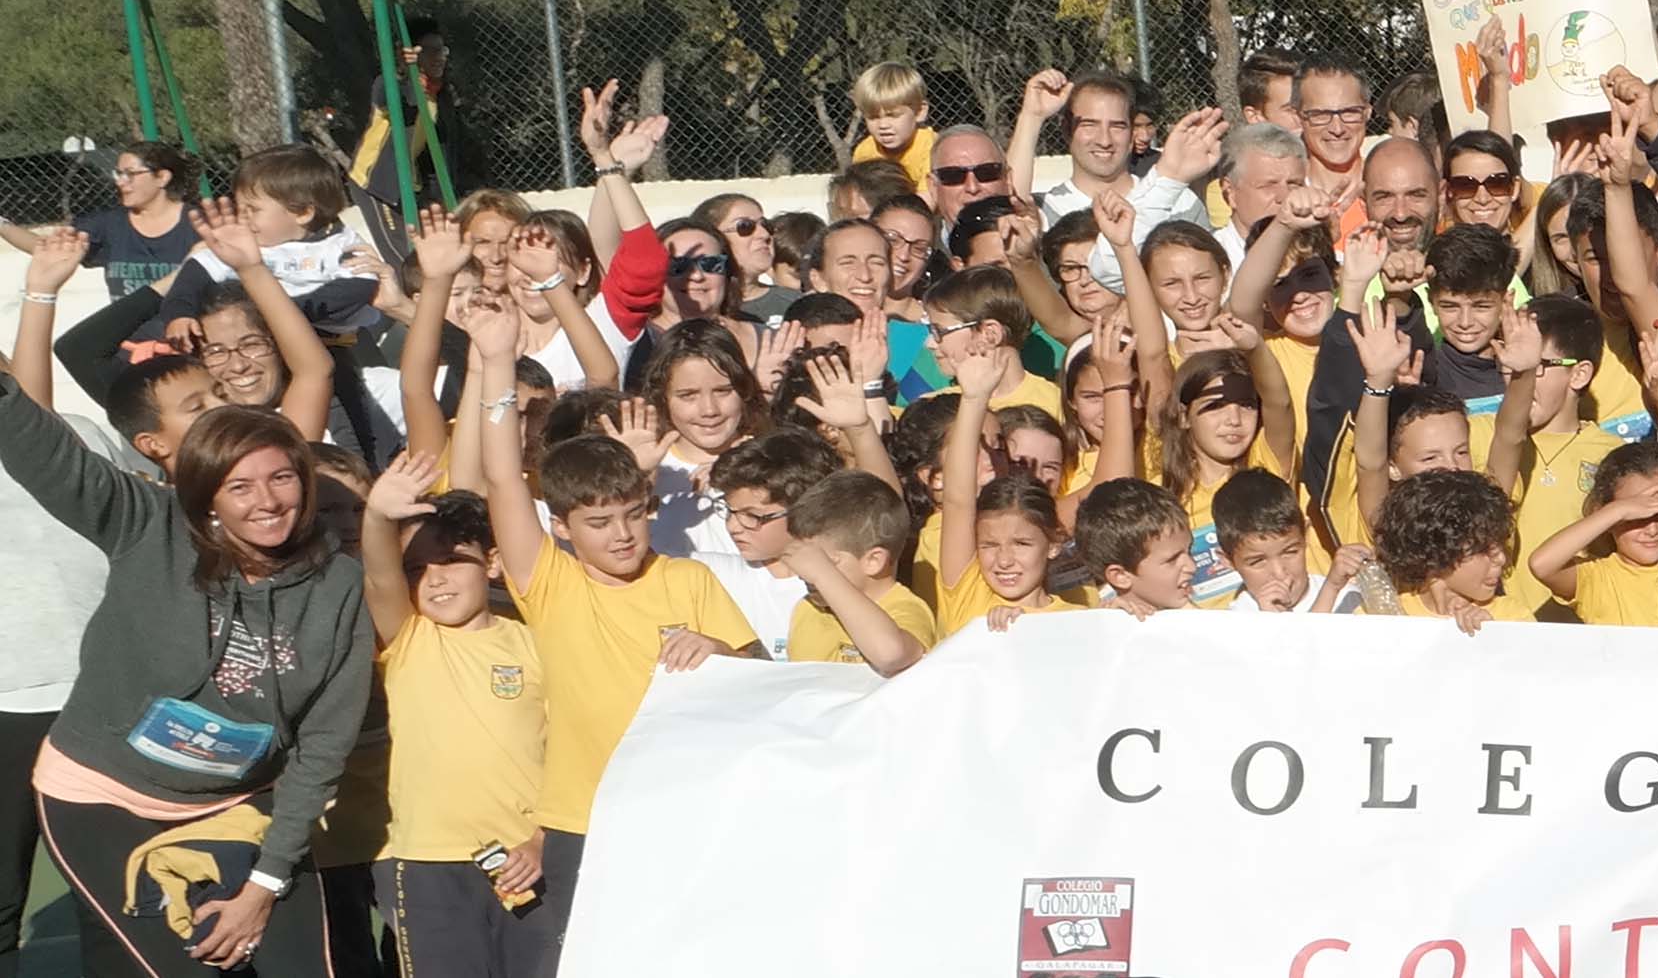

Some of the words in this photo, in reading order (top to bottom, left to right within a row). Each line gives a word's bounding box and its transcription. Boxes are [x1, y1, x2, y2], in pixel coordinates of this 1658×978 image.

[1455, 12, 1540, 114] Mdo
[1056, 880, 1103, 892] COLEGIO
[1039, 893, 1118, 915] GONDOMAR
